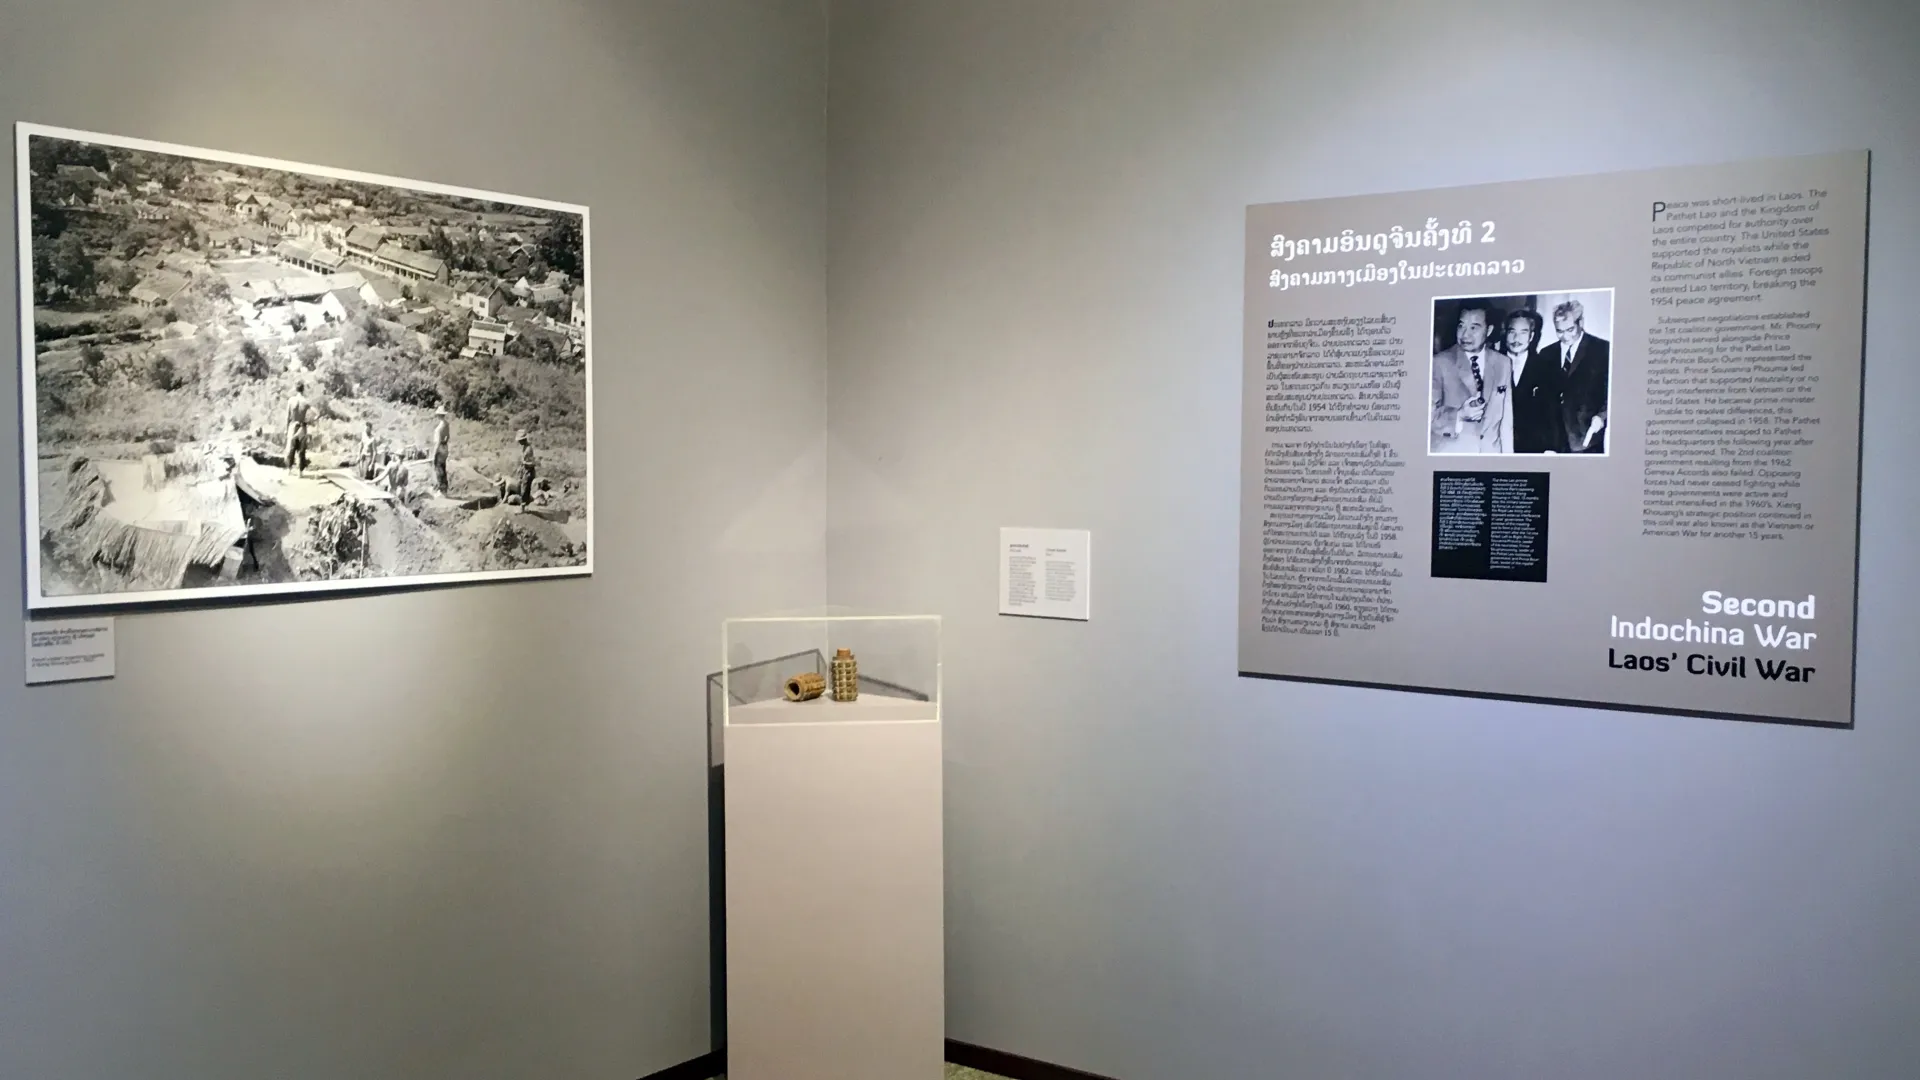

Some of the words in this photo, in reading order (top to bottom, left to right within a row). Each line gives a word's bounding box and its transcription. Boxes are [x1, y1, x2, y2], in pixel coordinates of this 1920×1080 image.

[1480, 221, 1496, 243] 2
[1702, 590, 1816, 620] Second
[1611, 615, 1744, 646] Indochina
[1754, 623, 1817, 650] War
[1608, 648, 1677, 672] Laos'
[1687, 653, 1746, 678] Civil
[1755, 658, 1816, 683] War
